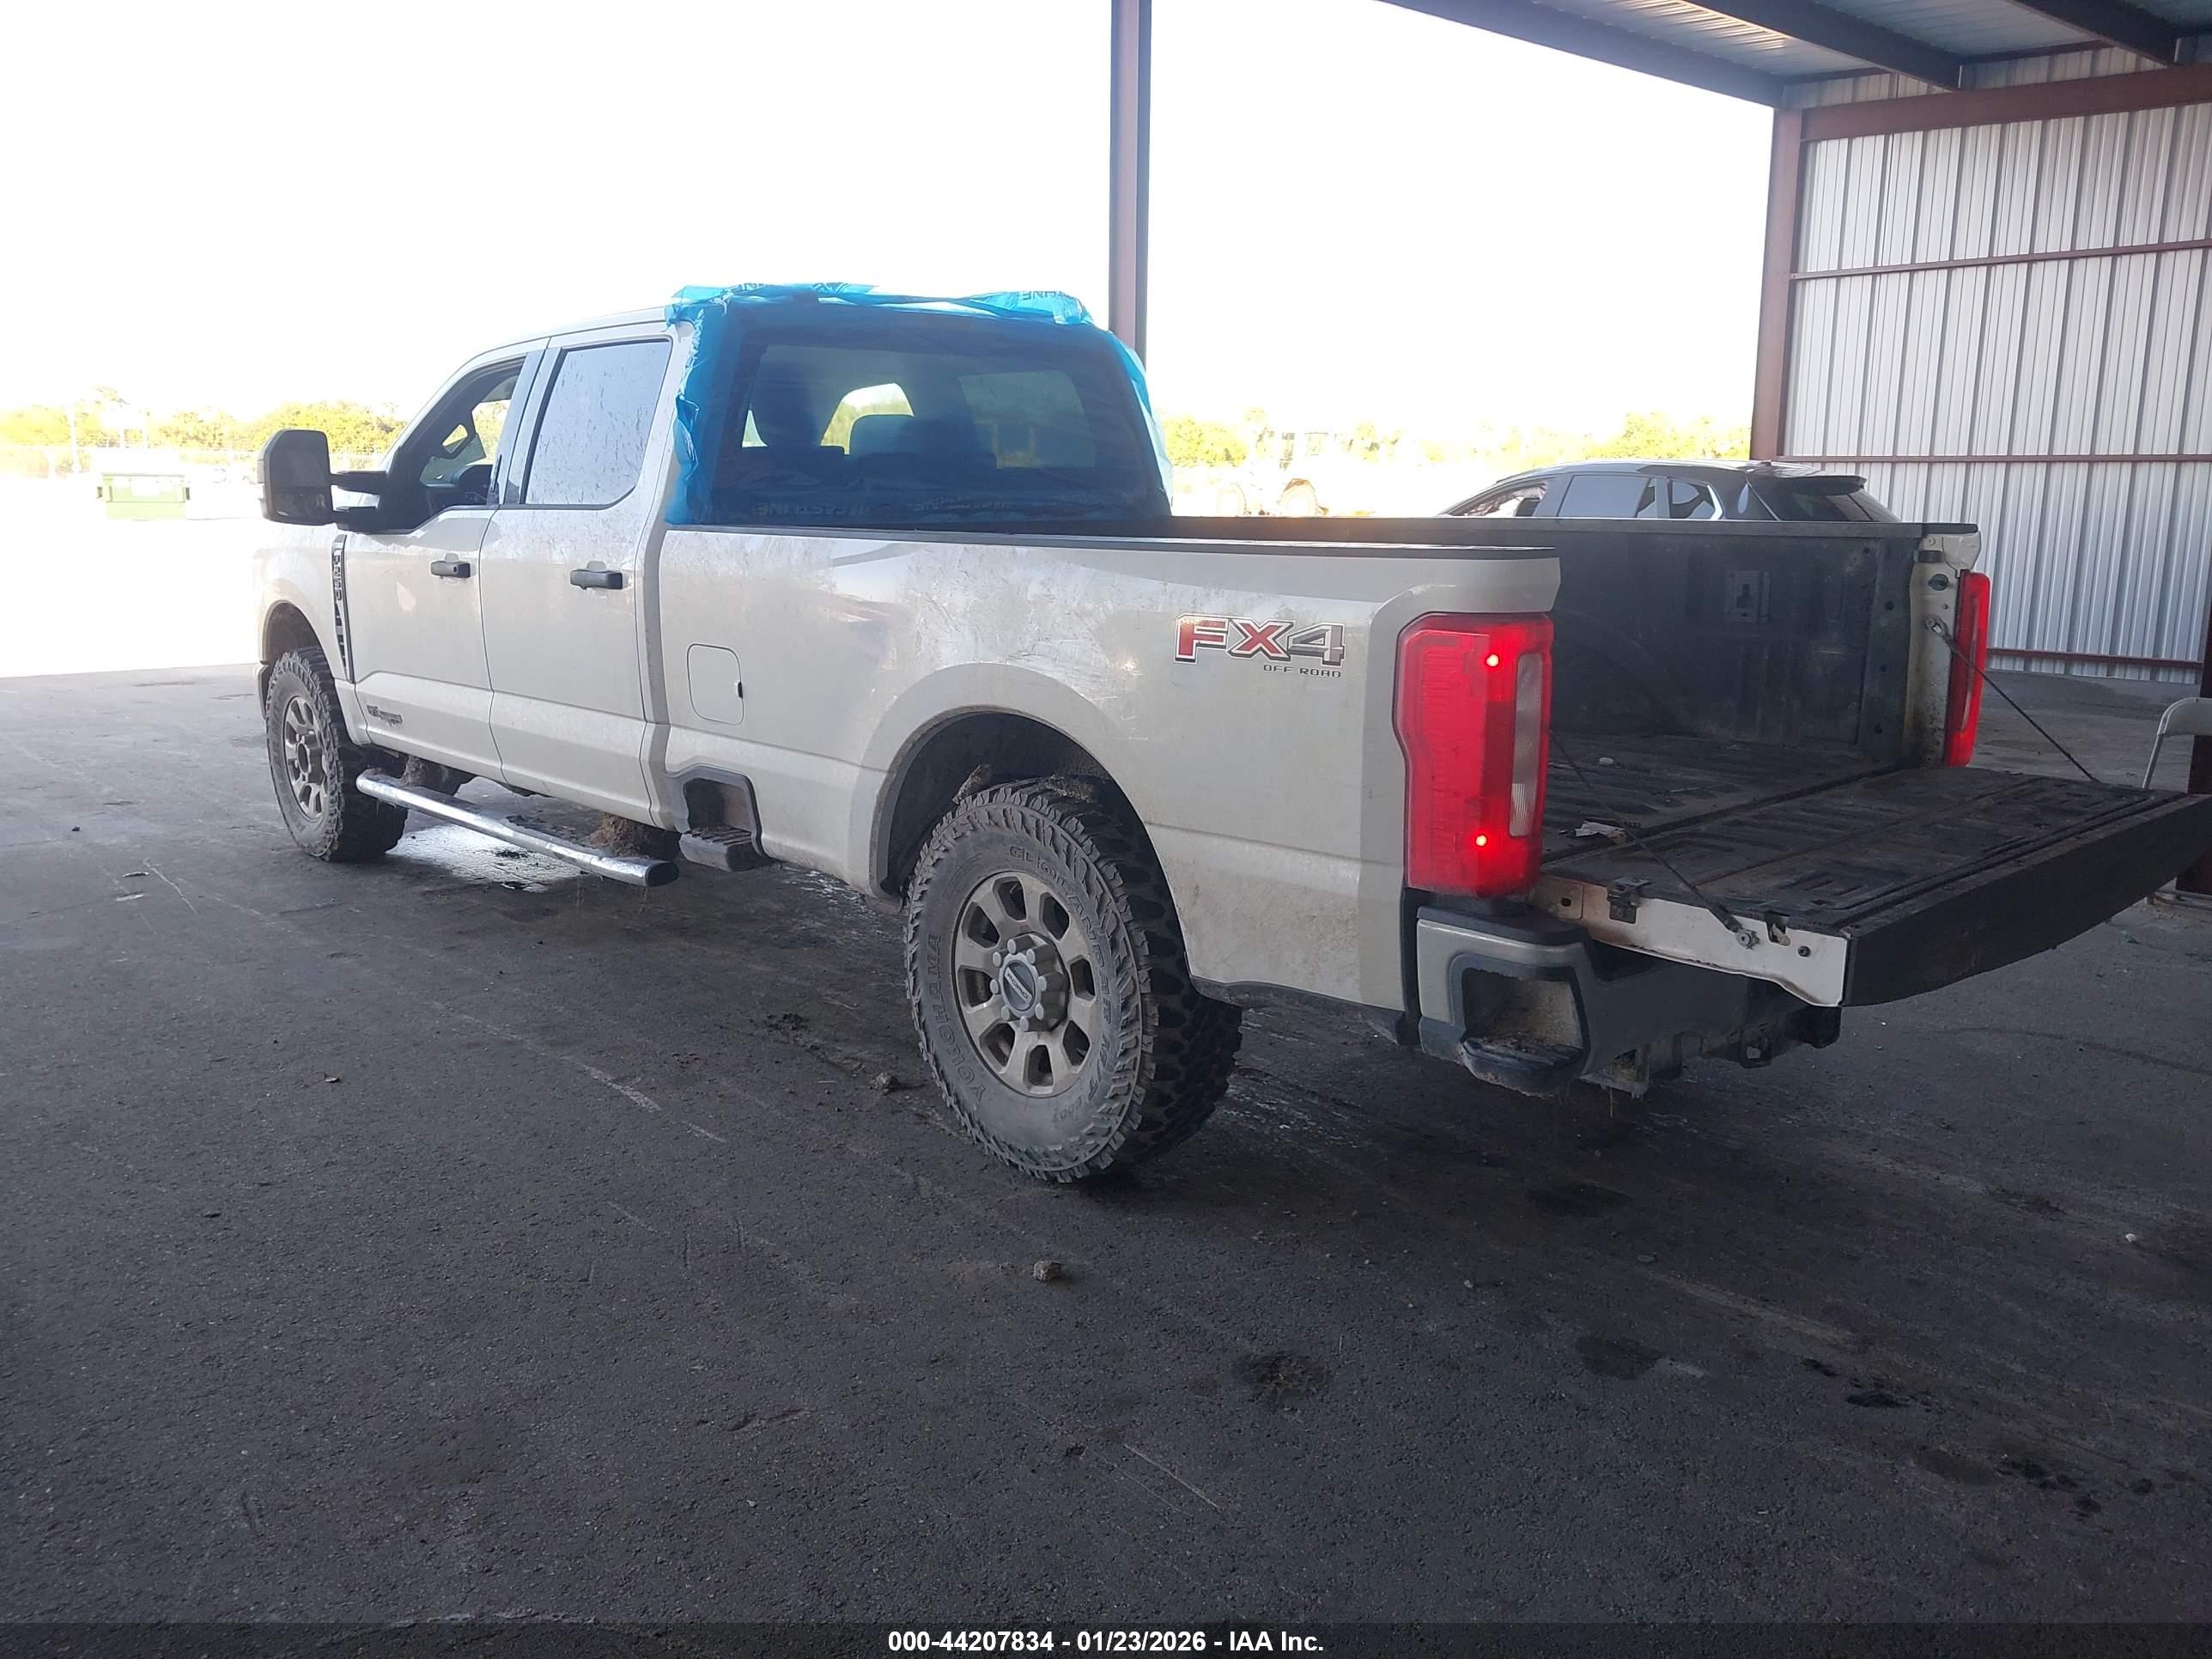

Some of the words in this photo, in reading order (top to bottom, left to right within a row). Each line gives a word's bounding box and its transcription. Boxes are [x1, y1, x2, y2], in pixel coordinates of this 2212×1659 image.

[1174, 613, 1346, 667] FX4
[1263, 664, 1295, 674] OFF
[1299, 667, 1341, 678] ROAD
[1006, 973, 1029, 1000] FORD
[927, 933, 986, 1102] YOKOHAMA
